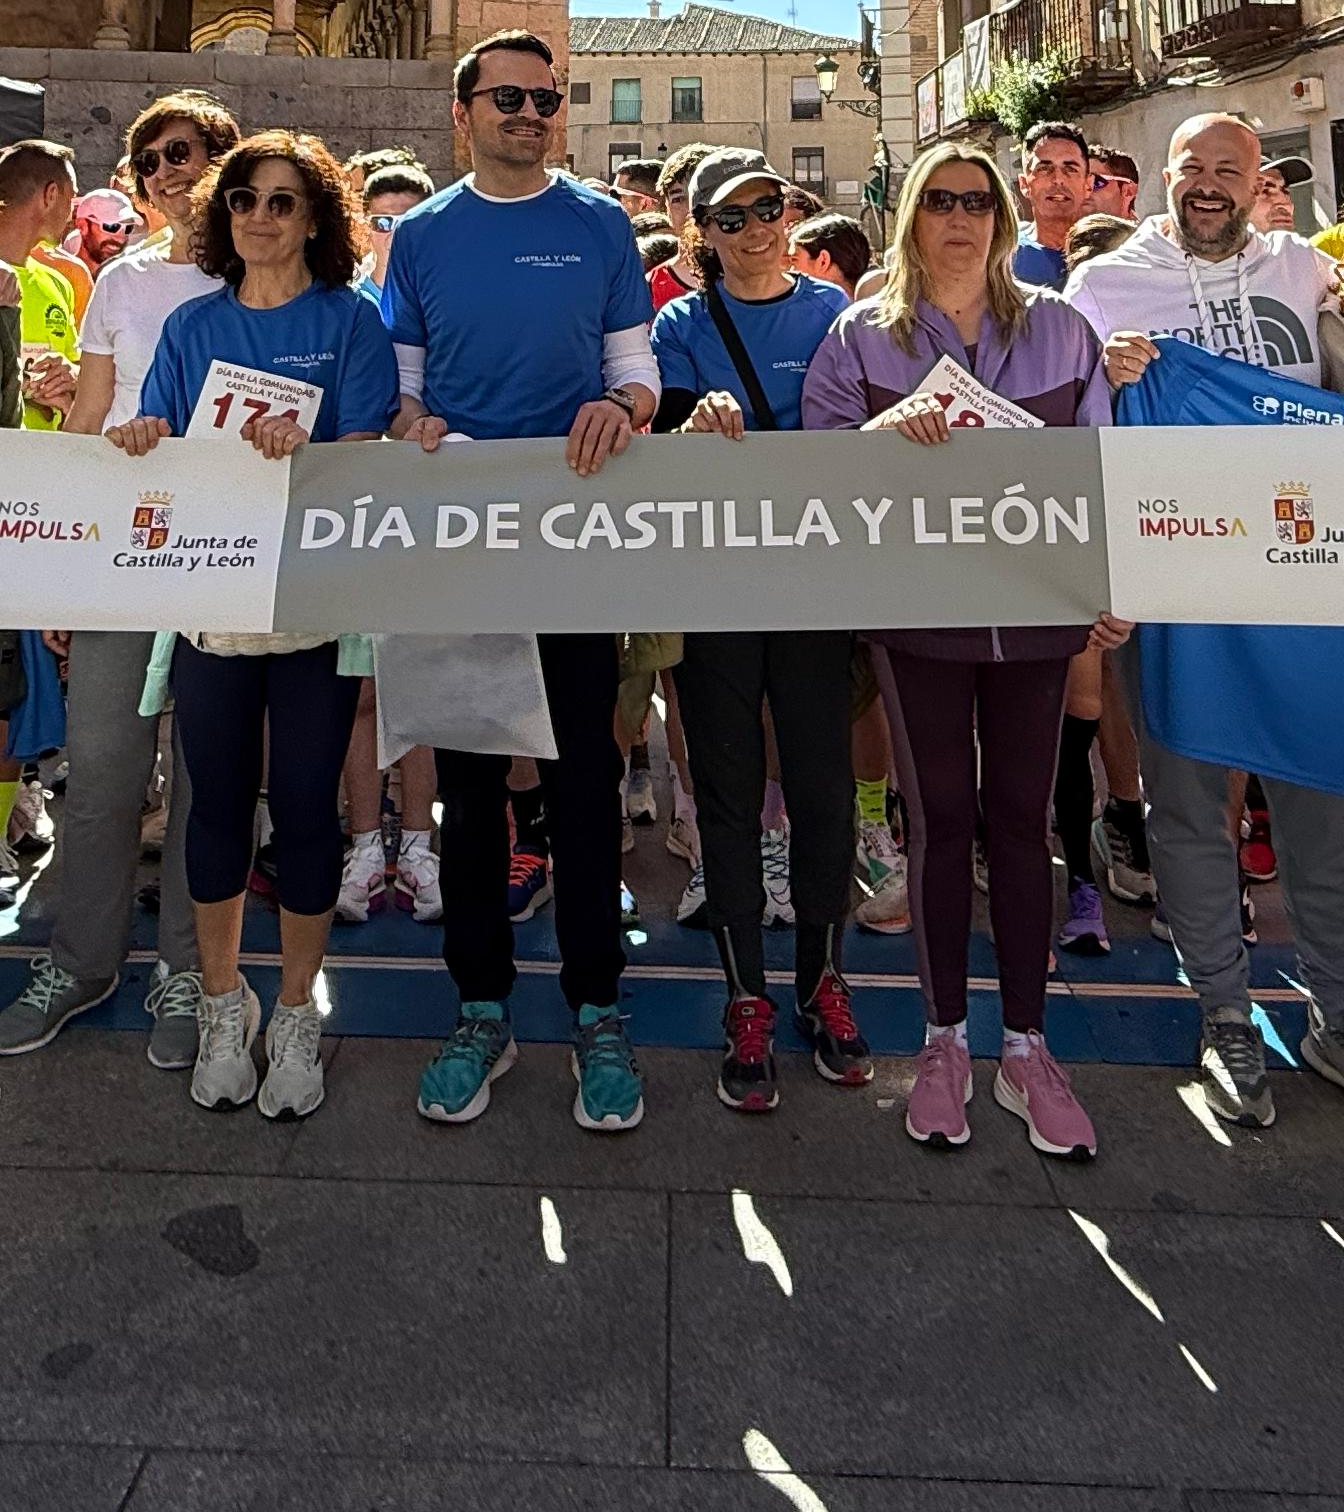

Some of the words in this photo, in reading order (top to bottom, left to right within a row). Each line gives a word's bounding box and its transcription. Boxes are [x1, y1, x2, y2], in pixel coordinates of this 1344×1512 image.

[514, 255, 551, 263] CASTILLA
[1189, 297, 1242, 324] THE
[273, 355, 309, 364] CASTILLA
[216, 367, 232, 378] DÍA
[234, 371, 245, 381] DE
[248, 375, 258, 385] LA
[226, 380, 265, 398] CASTILLA
[274, 391, 300, 406] LEÓN
[943, 364, 959, 379] DÍA
[959, 376, 972, 389] DE
[971, 386, 982, 399] LA
[982, 395, 1035, 428] COMUNIDAD
[949, 382, 987, 413] CASTILLA
[993, 410, 1018, 428] LEÓN
[1283, 400, 1344, 426] Plena
[300, 493, 417, 550] DÍA
[435, 502, 520, 550] DE
[540, 497, 841, 550] CASTILLA
[851, 497, 894, 546] Y
[912, 481, 1090, 546] LEÓN
[1137, 498, 1180, 515] NOS
[1139, 517, 1248, 541] IMPULSA
[170, 534, 227, 550] Junta
[233, 534, 258, 550] de
[112, 552, 184, 568] Castilla
[186, 554, 202, 572] y
[205, 551, 256, 569] León
[1266, 547, 1339, 565] Castilla
